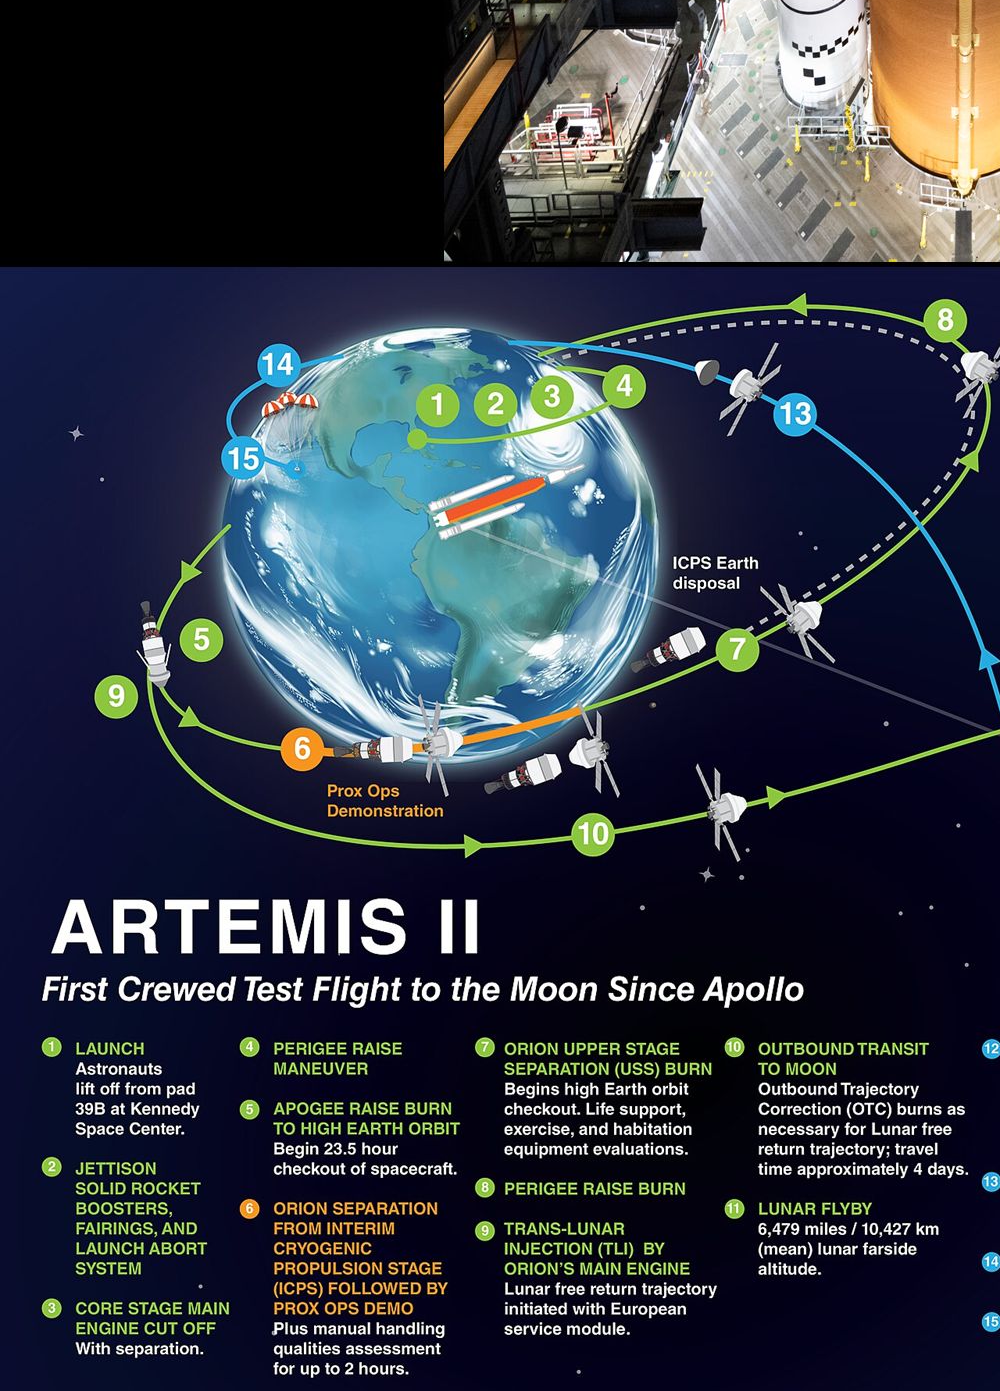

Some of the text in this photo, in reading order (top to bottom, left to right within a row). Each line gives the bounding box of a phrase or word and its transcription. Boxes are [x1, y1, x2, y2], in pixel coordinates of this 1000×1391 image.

[937, 307, 954, 331] 8
[262, 352, 294, 375] 14
[615, 373, 634, 397] 4
[431, 392, 443, 415] 1
[487, 392, 504, 415] 2
[544, 385, 561, 409] 3
[780, 401, 811, 425] 13
[229, 446, 261, 470] 15
[673, 555, 759, 570] ICPS Earth
[672, 574, 740, 595] disposal
[194, 627, 210, 651] 5
[729, 637, 746, 660] 7
[108, 684, 125, 707] 9
[295, 736, 311, 760] 6
[327, 783, 400, 801] Prox Ops
[327, 803, 444, 818] Demonstration
[578, 822, 609, 845] 10
[50, 897, 480, 956] ARTEMIS II
[41, 975, 804, 1009] First Crewed Test Flight to the Moon Since Apollo
[48, 1041, 54, 1052] 1
[75, 1041, 145, 1056] LAUNCH
[245, 1041, 254, 1052] 4
[273, 1041, 403, 1056] PERIGEE RAISE
[727, 1041, 741, 1052] 10
[757, 1041, 930, 1056] OUTBOUND TRANSIT
[75, 1061, 163, 1076] Astronauts
[273, 1061, 369, 1076] MANEUVER
[757, 1061, 837, 1076] TO MOON
[75, 1081, 196, 1099] lift off from pad
[75, 1101, 201, 1119] 39B at Kennedy
[246, 1104, 254, 1115] 5
[273, 1101, 452, 1116] APOGEE RAISE BURN
[75, 1121, 185, 1139] Space Center.
[273, 1121, 461, 1136] TO HIGH EARTH ORBIT
[273, 1141, 399, 1159] Begin 23.5 hour
[48, 1161, 56, 1172] 2
[75, 1161, 157, 1175] JETTISON
[273, 1161, 457, 1179] checkout of spacecraft.
[75, 1181, 201, 1195] SOLID ROCKET
[481, 1181, 489, 1193] 8
[504, 1181, 686, 1196] PERIGEE RAISE BURN
[984, 1175, 998, 1187] 13
[75, 1201, 173, 1218] BOOSTERS,
[727, 1203, 739, 1214] 11
[758, 1201, 873, 1216] LUNAR FLYBY
[75, 1221, 198, 1238] FAIRINGS, AND
[757, 1221, 939, 1239] 6,479 miles / 10,427 km
[75, 1241, 208, 1255] LAUNCH ABORT
[757, 1241, 917, 1259] (mean) lunar farside
[75, 1261, 141, 1275] SYSTEM
[757, 1261, 822, 1276] altitude.
[984, 1256, 999, 1267] 14
[48, 1302, 56, 1314] 3
[75, 1301, 230, 1315] CORE STAGE MAIN
[75, 1321, 217, 1335] ENGINE CUT OFF
[984, 1316, 999, 1327] 15
[75, 1341, 205, 1359] With separation.
